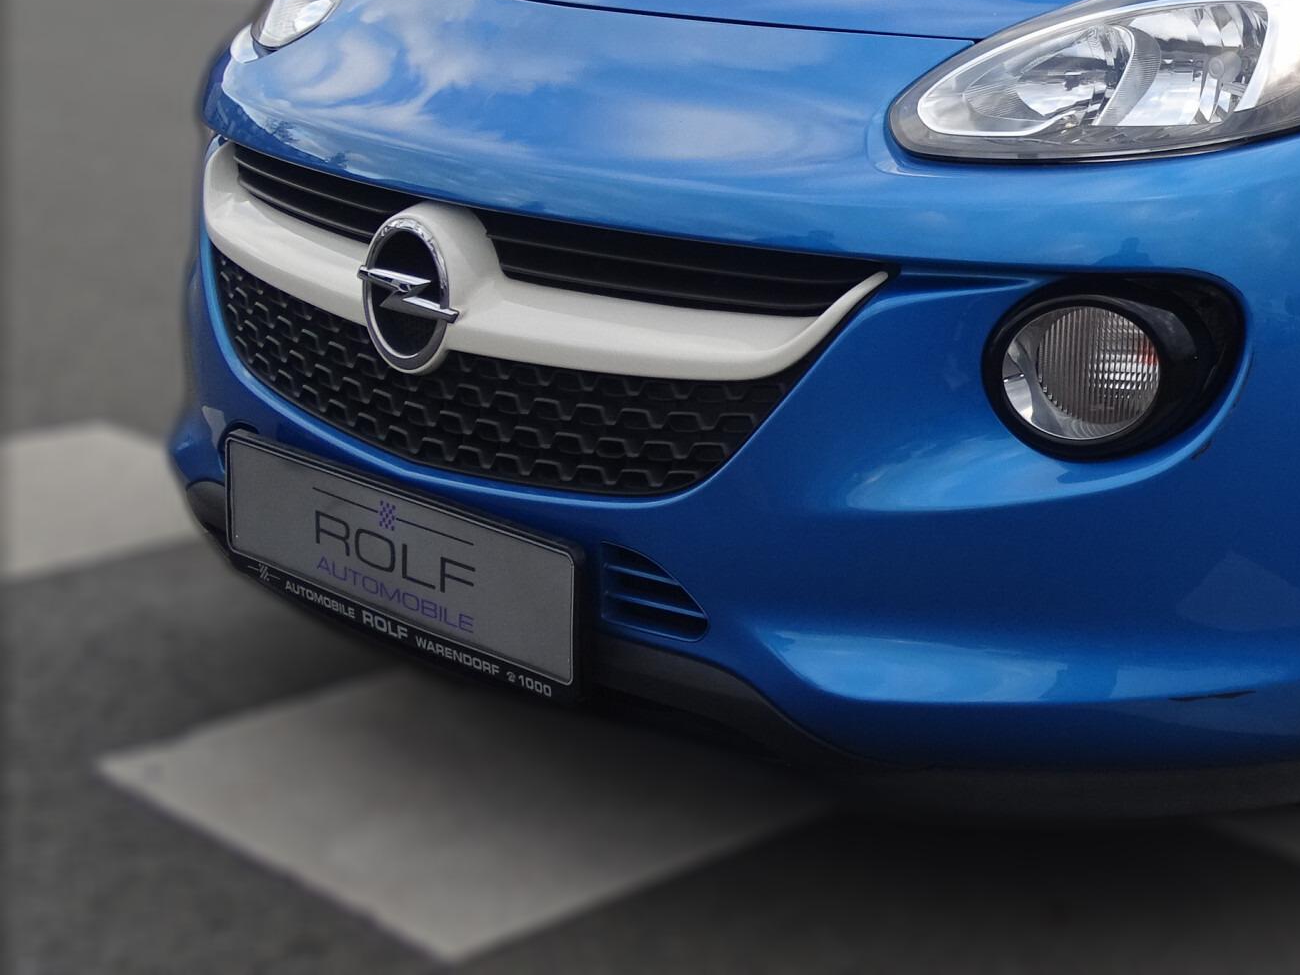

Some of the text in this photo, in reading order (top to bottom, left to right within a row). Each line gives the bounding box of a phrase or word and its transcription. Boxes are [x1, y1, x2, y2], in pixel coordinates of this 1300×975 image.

[315, 510, 476, 593] ROLF
[285, 579, 355, 619] AUTOMOBILE
[362, 609, 409, 640] ROLF
[415, 635, 500, 675] WARENDORF
[317, 555, 475, 634] AUTOMOBILE
